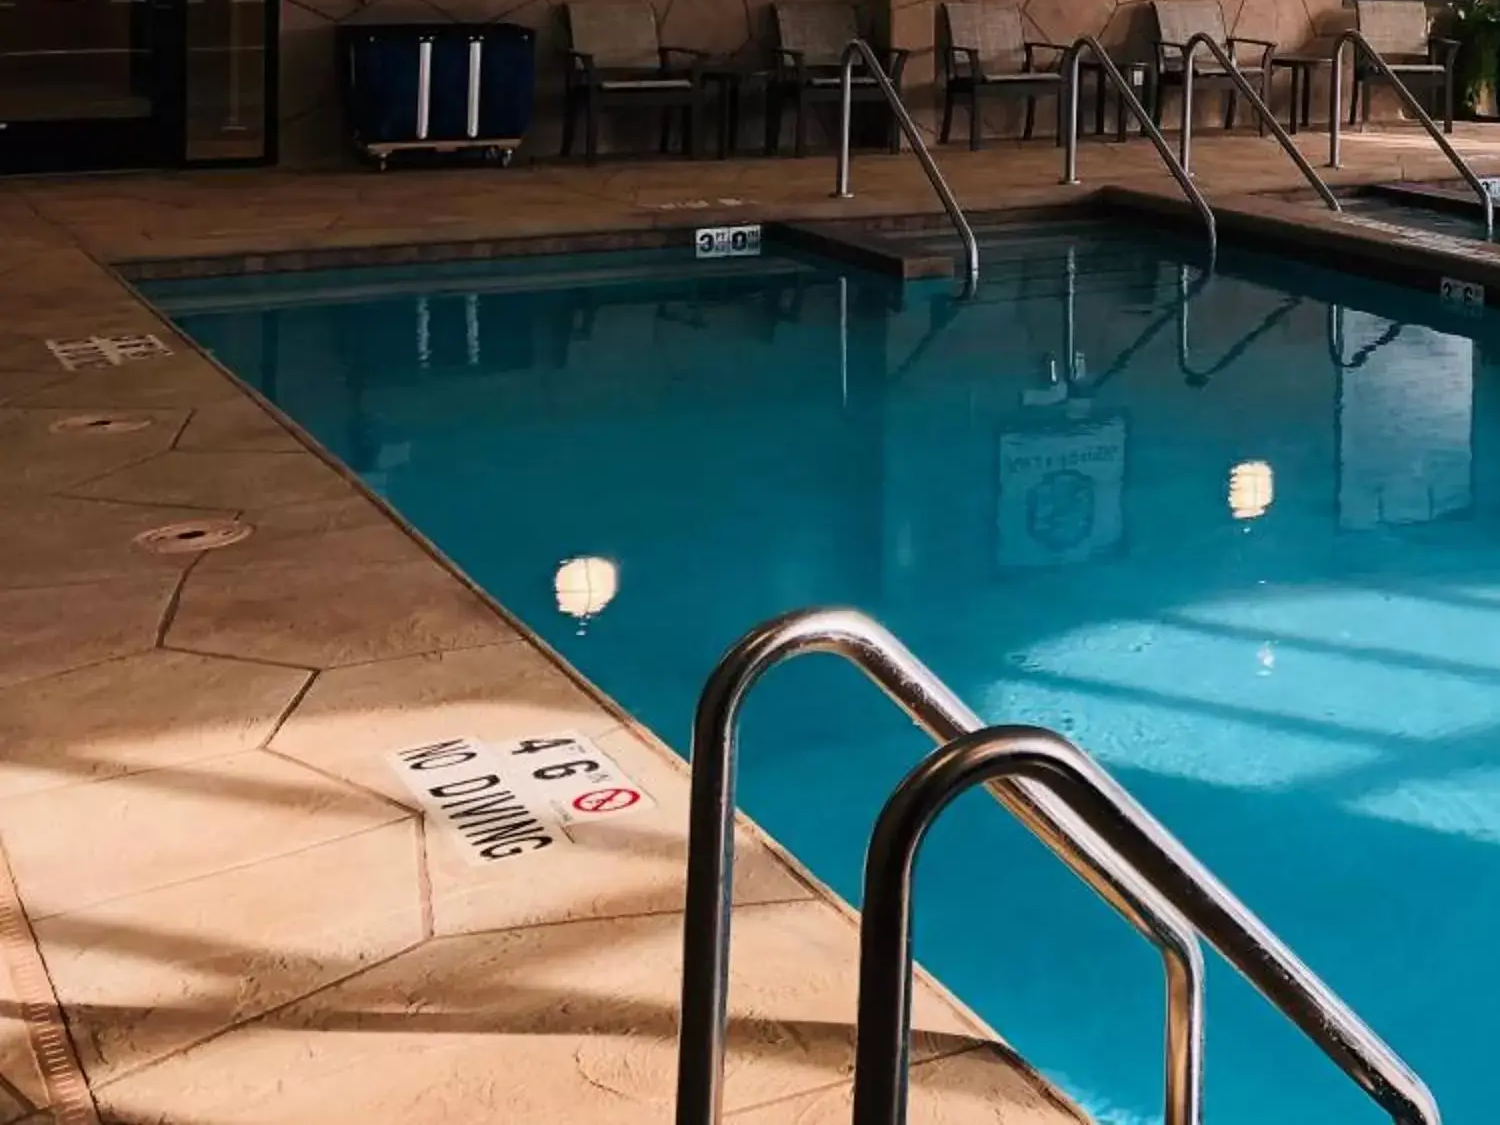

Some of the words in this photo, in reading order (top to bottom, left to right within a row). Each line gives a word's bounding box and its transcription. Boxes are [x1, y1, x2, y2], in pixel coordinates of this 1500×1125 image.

[397, 738, 477, 770] NO
[511, 738, 577, 756] 4
[532, 760, 600, 780] 6
[427, 774, 553, 861] DIVING
